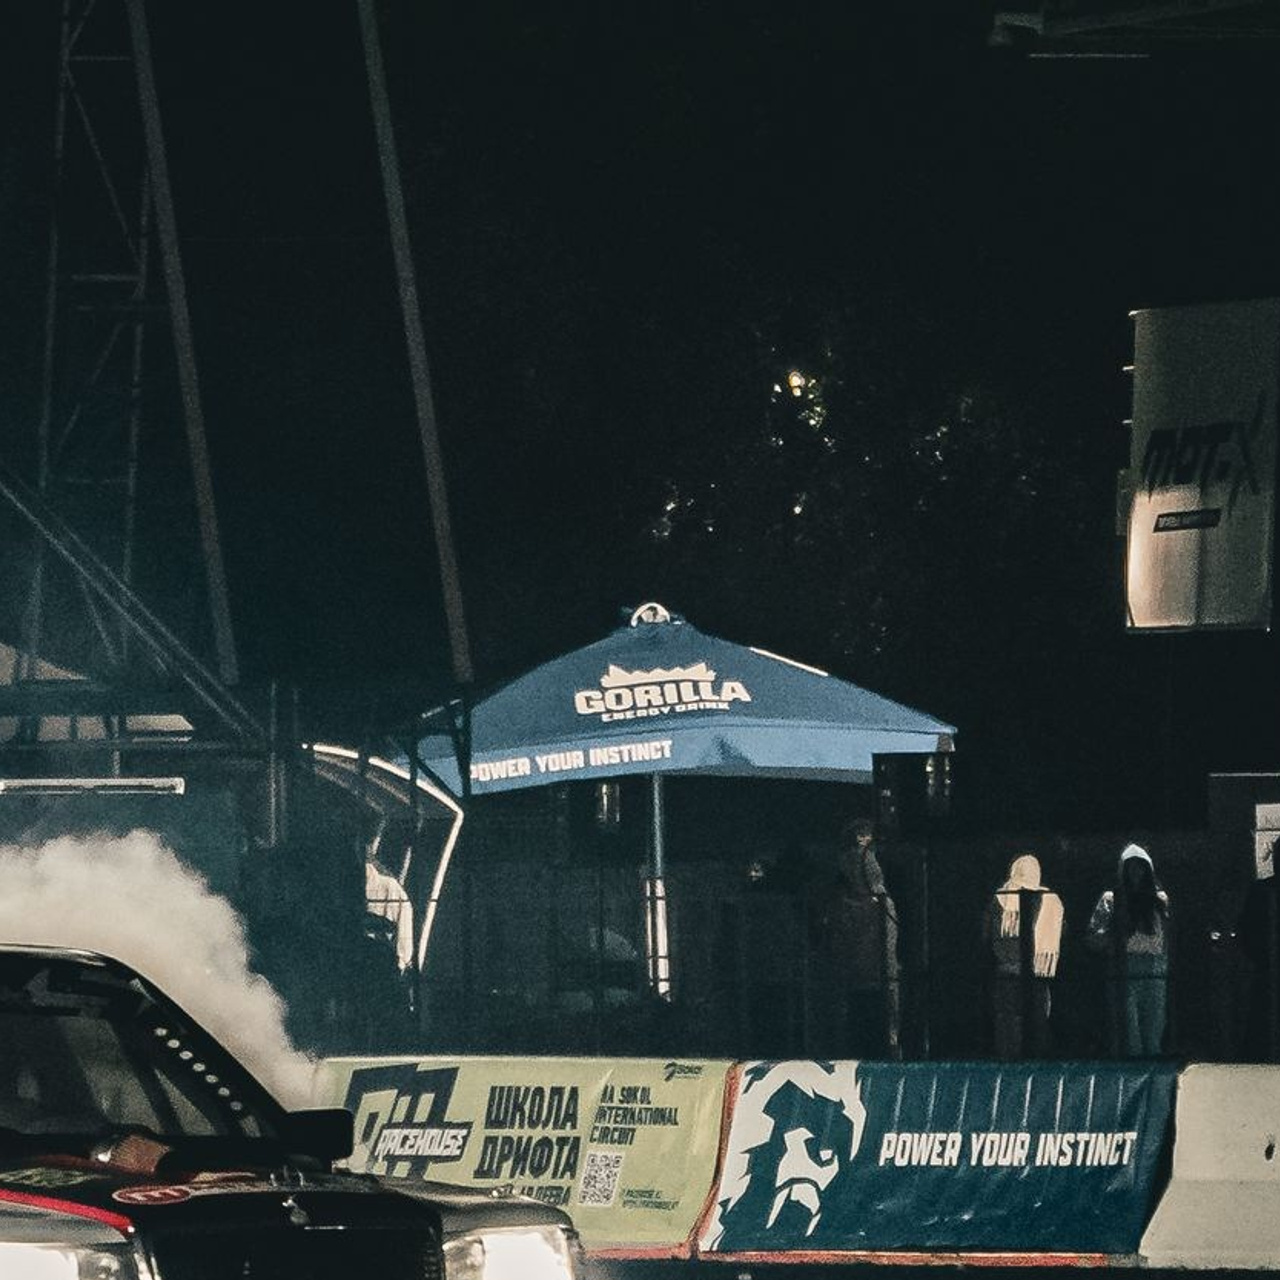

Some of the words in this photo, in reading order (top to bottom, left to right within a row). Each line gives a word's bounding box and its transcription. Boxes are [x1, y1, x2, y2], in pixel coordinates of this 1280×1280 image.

[575, 680, 752, 715] GORILLA
[536, 751, 584, 773] YOUR
[590, 740, 673, 767] INSTINCT
[483, 1085, 580, 1131] ШКОЛА
[594, 1105, 679, 1126] INTERNATIONAL
[374, 1127, 469, 1162] RACEHOUSE
[589, 1125, 637, 1146] CIRCUIT
[879, 1133, 962, 1166] POWER
[970, 1133, 1029, 1166] YOUR
[1035, 1132, 1137, 1166] INSTINCT
[473, 1135, 582, 1179] ДРИФТА
